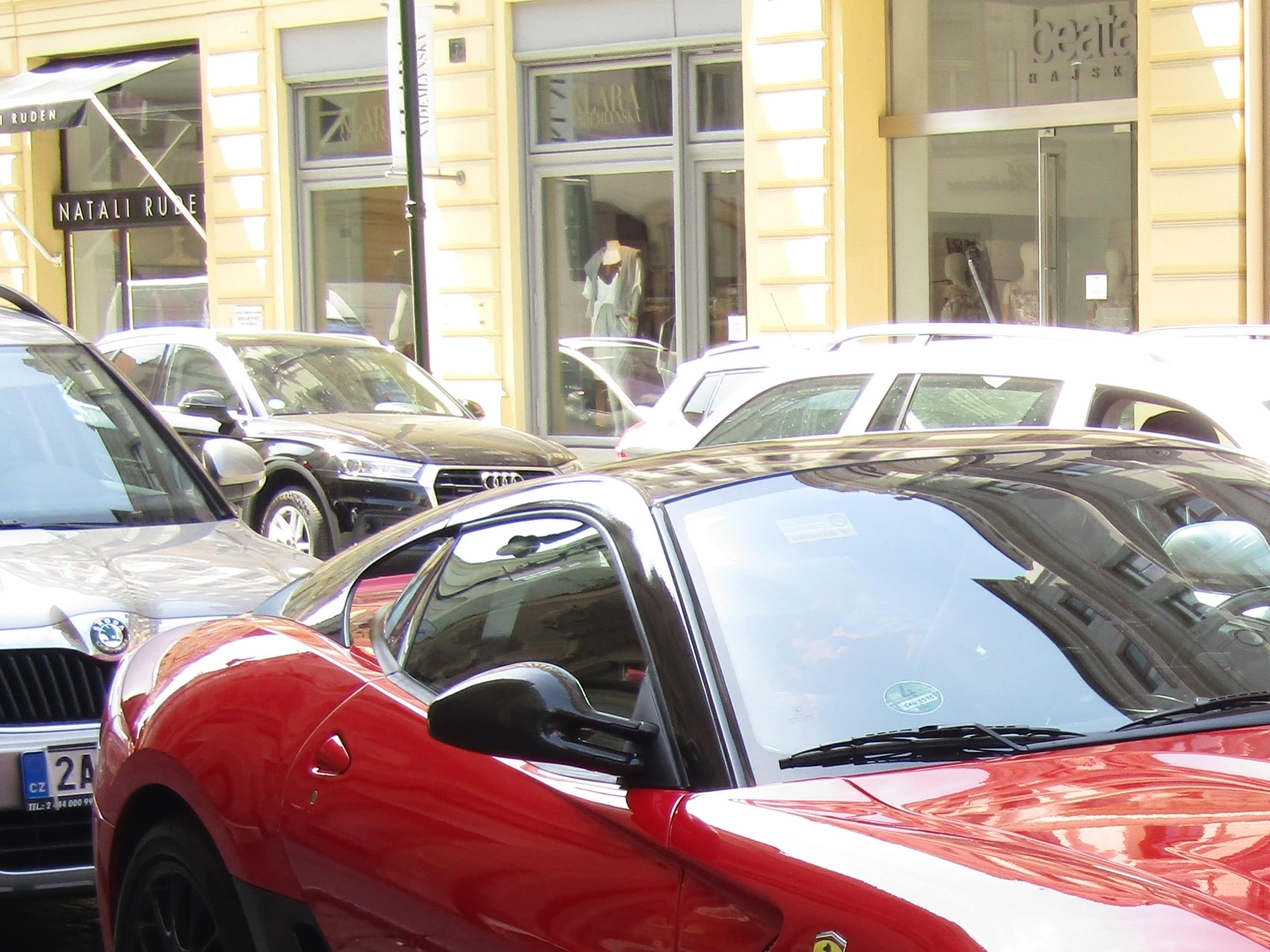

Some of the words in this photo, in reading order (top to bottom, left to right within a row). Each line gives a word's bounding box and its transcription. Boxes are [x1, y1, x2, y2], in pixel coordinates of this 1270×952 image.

[1033, 5, 1136, 64] beata
[1029, 65, 1137, 84] RAJSK
[12, 109, 57, 124] RUDEN
[59, 198, 130, 222] NATALI
[29, 782, 46, 793] CZ
[68, 798, 82, 807] 000
